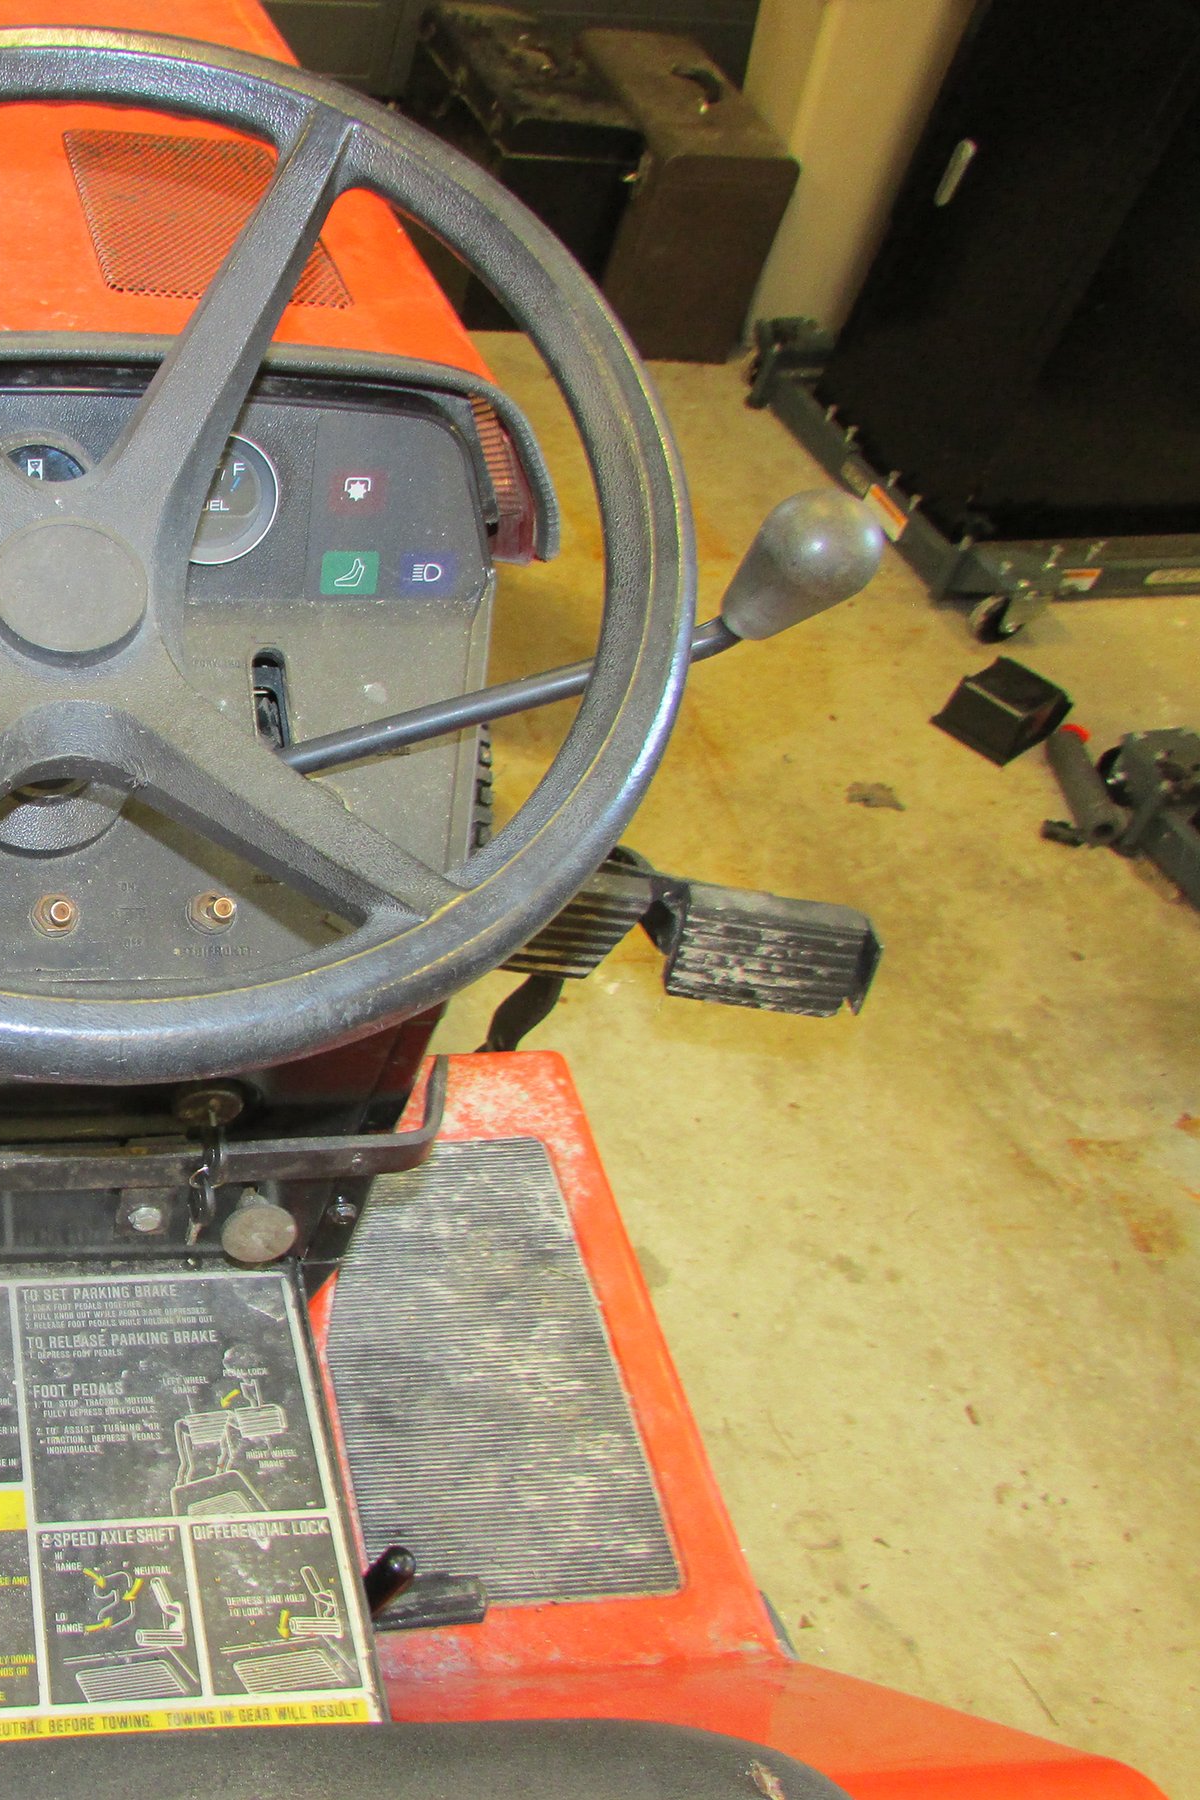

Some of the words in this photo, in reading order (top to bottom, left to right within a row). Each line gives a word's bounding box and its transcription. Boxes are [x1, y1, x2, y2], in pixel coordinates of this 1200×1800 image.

[234, 463, 245, 476] F
[22, 1289, 38, 1302] TO
[44, 1288, 67, 1301] SET
[73, 1286, 130, 1300] PARKING
[134, 1284, 177, 1298] BRAKE
[75, 1302, 102, 1310] PEDALS
[33, 1312, 51, 1320] PULL
[68, 1320, 86, 1328] FOOT
[176, 1316, 197, 1324] KNOB
[26, 1336, 43, 1349] TO
[49, 1334, 106, 1348] RELEASE
[111, 1332, 169, 1346] PARKING
[174, 1330, 218, 1344] BRAKE
[33, 1384, 67, 1399] FOOT
[73, 1382, 124, 1397] PEDALS
[42, 1401, 53, 1409] TO
[59, 1400, 79, 1409] STOP
[43, 1410, 67, 1418] FULLY
[10, 1426, 18, 1435] IN
[64, 1425, 96, 1435] ASSIST
[103, 1423, 141, 1433] TURNING
[92, 1434, 127, 1443] DEPRESS
[132, 1432, 161, 1441] PEDALS
[192, 1521, 291, 1540] DIFFERENTIAL
[292, 1519, 331, 1536] LOCK
[54, 1531, 97, 1548] SPEED
[100, 1529, 134, 1546] AXLE
[136, 1526, 177, 1543] SHIFT
[56, 1562, 82, 1572] RANGE
[56, 1612, 67, 1622] LO
[56, 1623, 84, 1633] RANGE
[48, 1718, 96, 1734] BEFORE
[99, 1714, 154, 1731] TOWING.
[166, 1710, 215, 1727] TOWING
[238, 1707, 271, 1722] GEAR
[275, 1706, 307, 1720] WILL
[312, 1702, 359, 1720] RESULT
